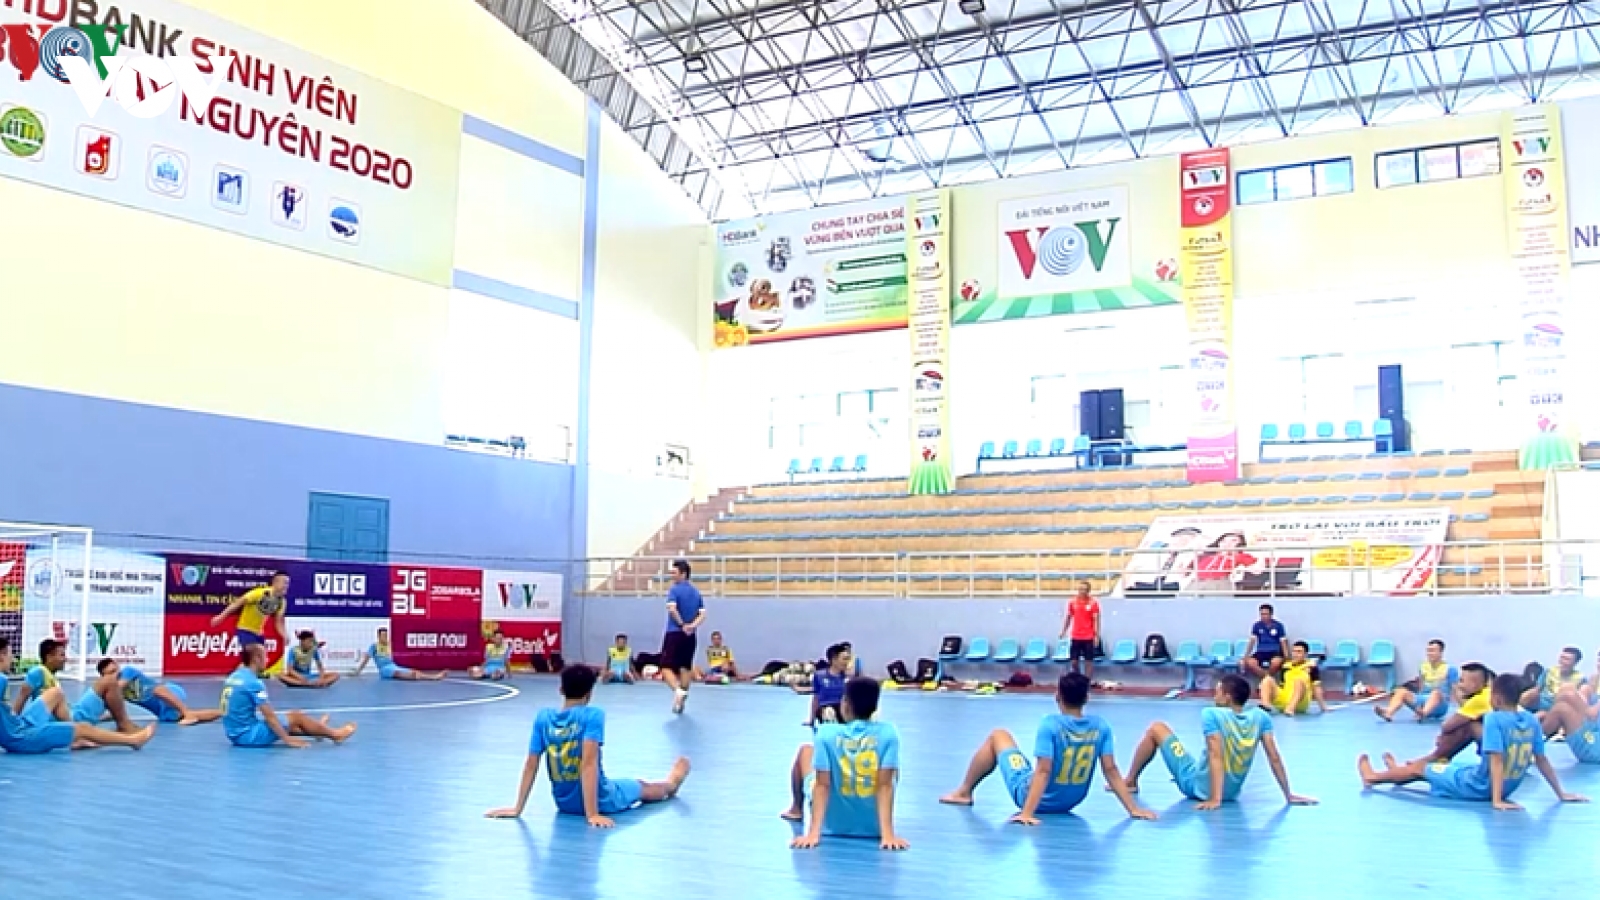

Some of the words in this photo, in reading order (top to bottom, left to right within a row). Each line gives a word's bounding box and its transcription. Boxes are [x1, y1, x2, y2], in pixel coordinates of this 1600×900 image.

[283, 67, 358, 125] VIÊN
[329, 136, 413, 189] 2020
[1004, 216, 1121, 280] VOV
[315, 574, 365, 594] VTC
